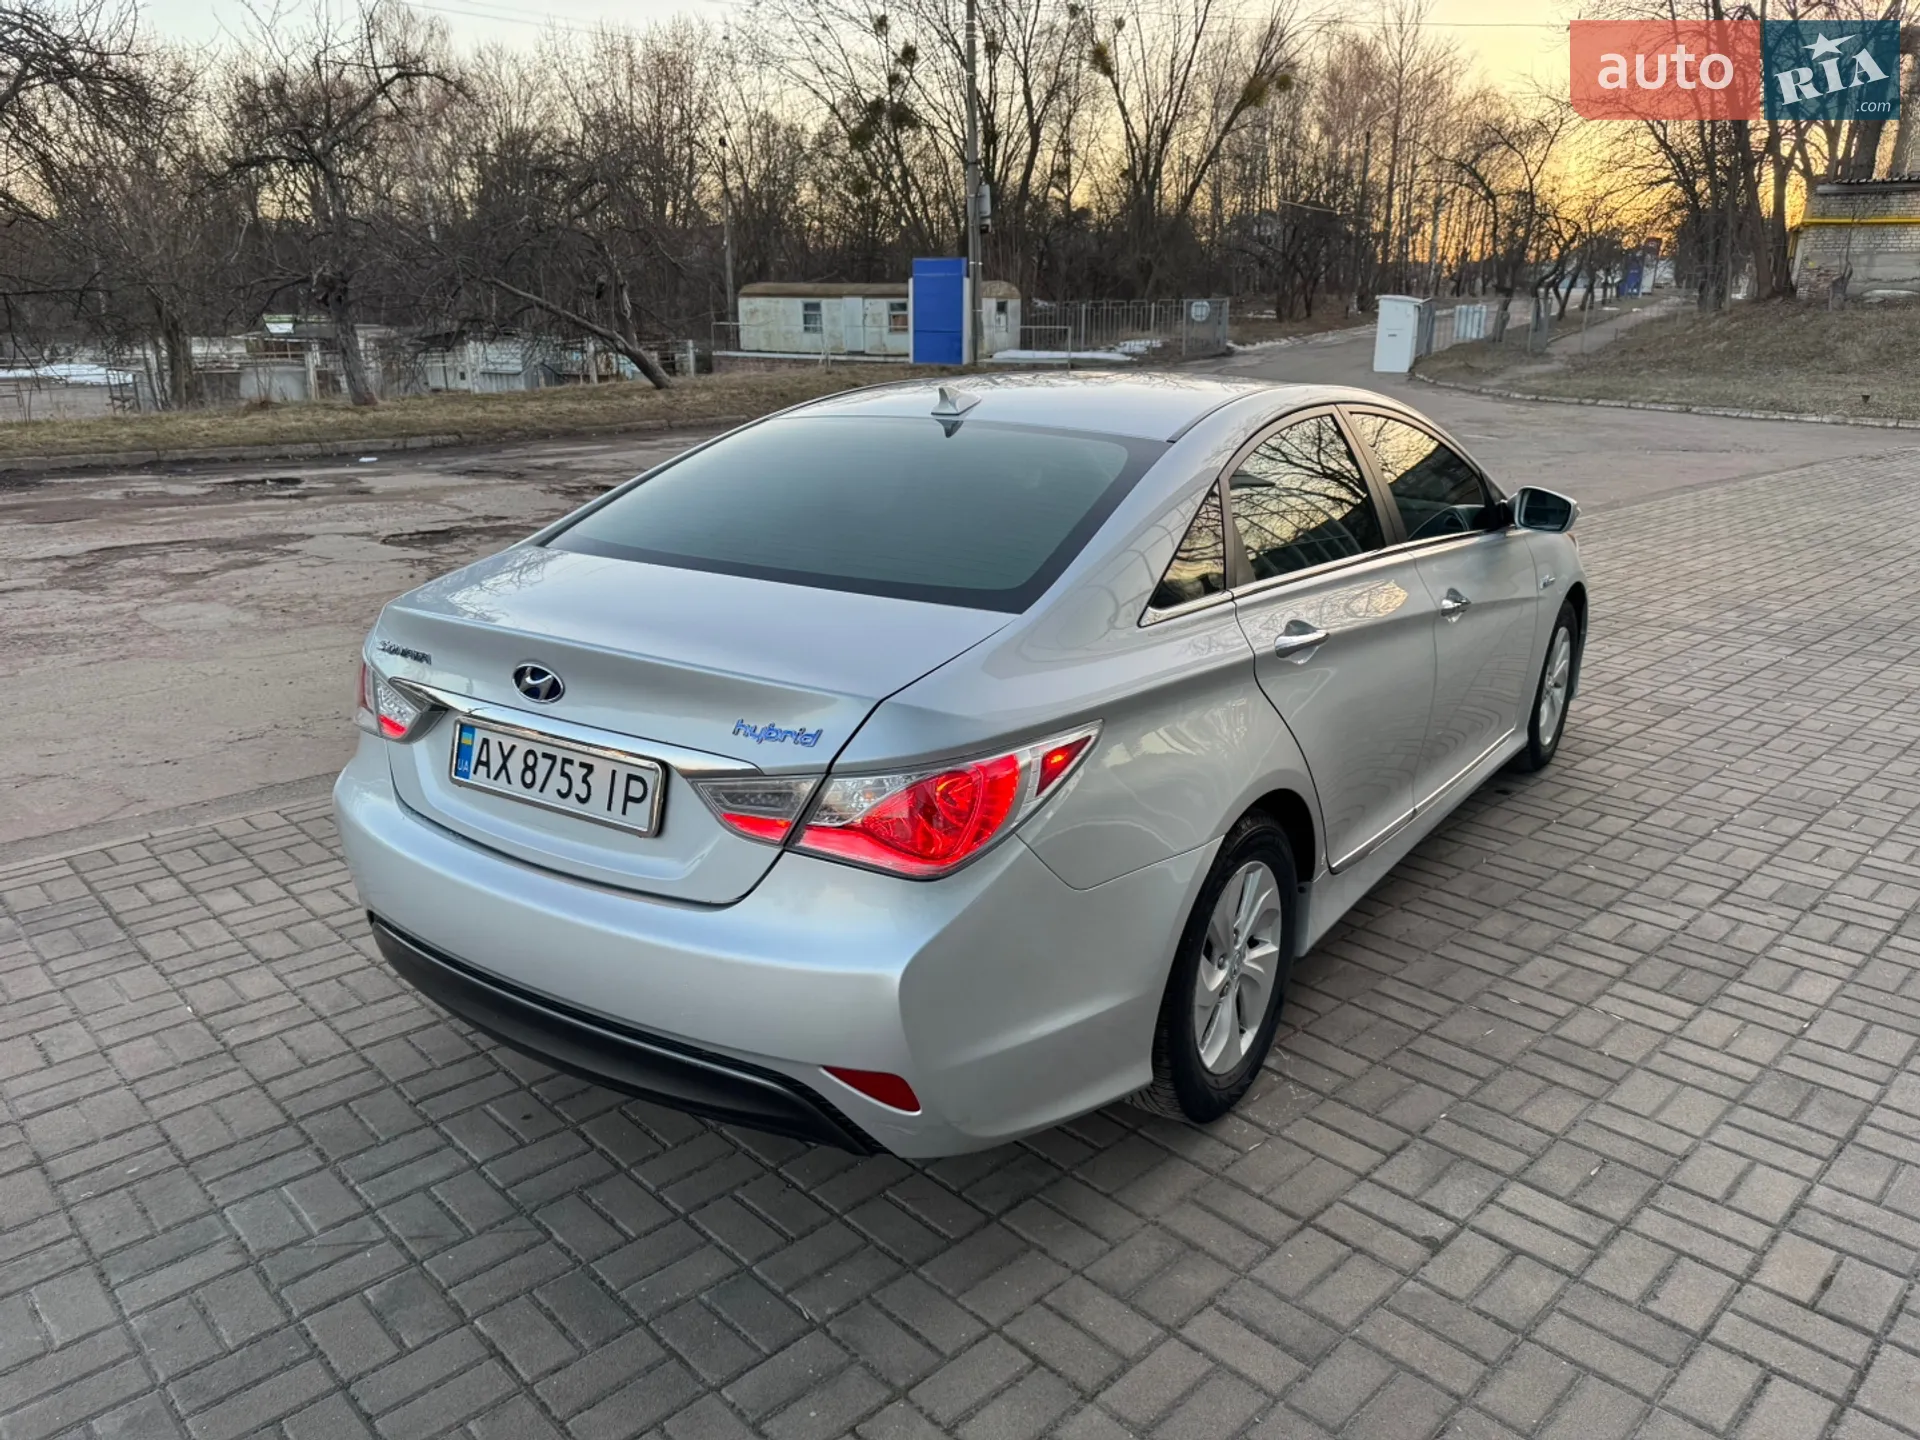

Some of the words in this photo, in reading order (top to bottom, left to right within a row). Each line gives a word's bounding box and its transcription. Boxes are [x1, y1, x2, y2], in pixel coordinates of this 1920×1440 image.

[732, 718, 823, 748] hybrid
[457, 757, 469, 772] UA
[473, 737, 517, 785] AX
[520, 749, 596, 804] 8753
[606, 769, 649, 816] IP
